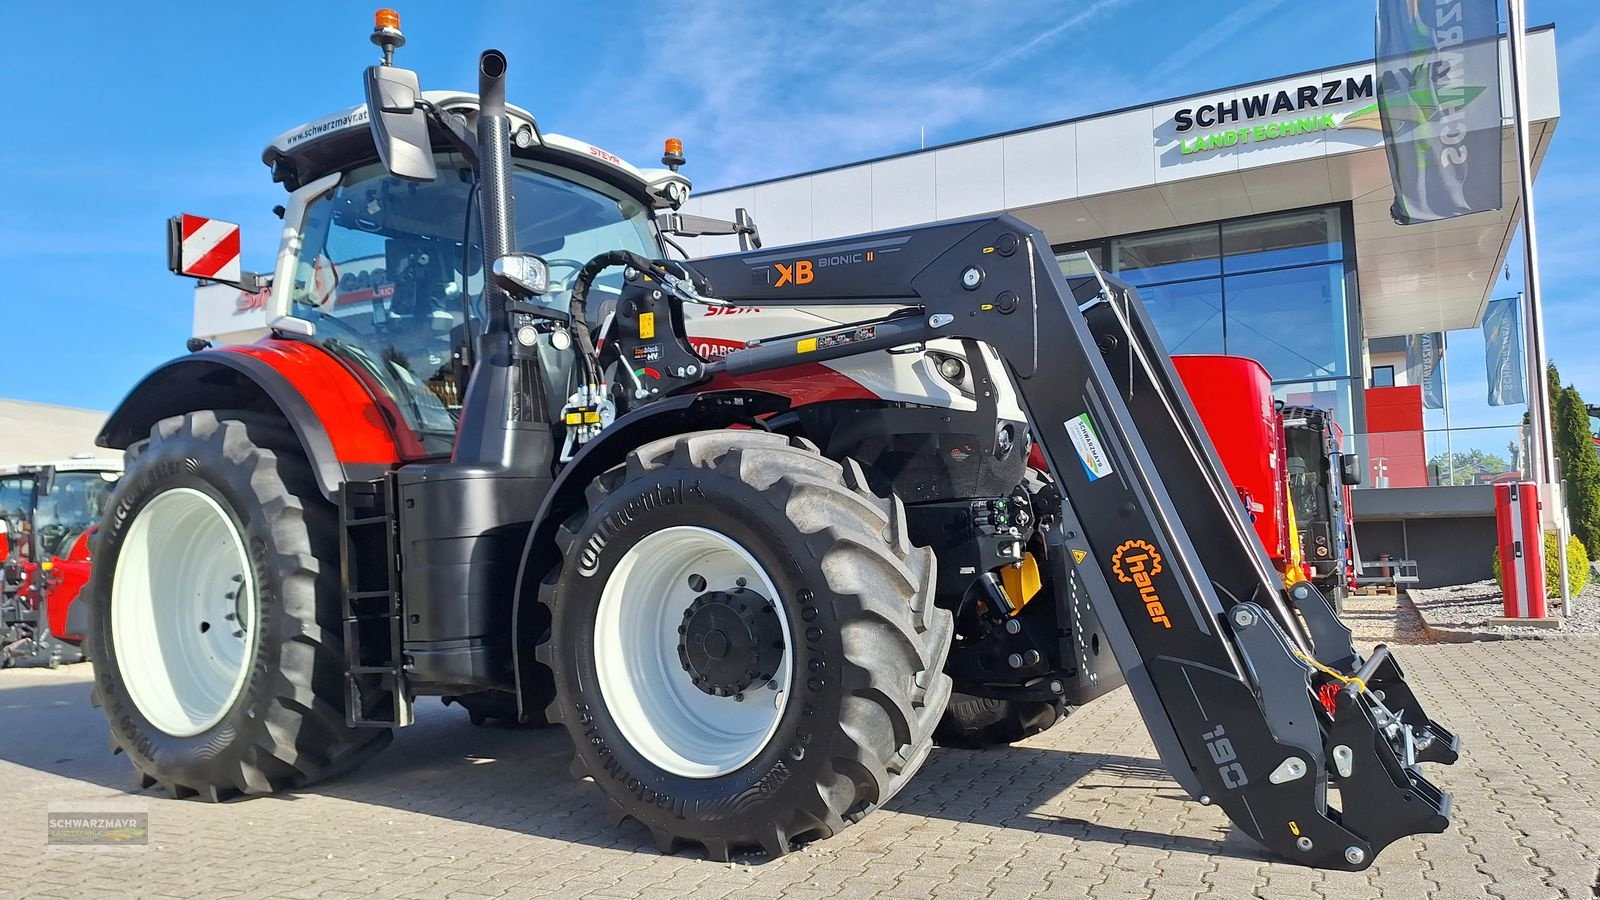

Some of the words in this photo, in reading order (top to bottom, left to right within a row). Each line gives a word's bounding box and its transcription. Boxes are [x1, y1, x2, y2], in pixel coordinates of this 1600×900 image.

[287, 110, 368, 144] www.schwarzmayr.at
[1181, 112, 1337, 155] LANDTECHNIK
[590, 146, 620, 165] STEYR
[818, 253, 863, 268] BIONIC
[647, 352, 659, 361] HV
[1078, 421, 1103, 468] SCHWARZMAYR
[577, 479, 685, 578] Continental
[1125, 553, 1172, 629] hauer
